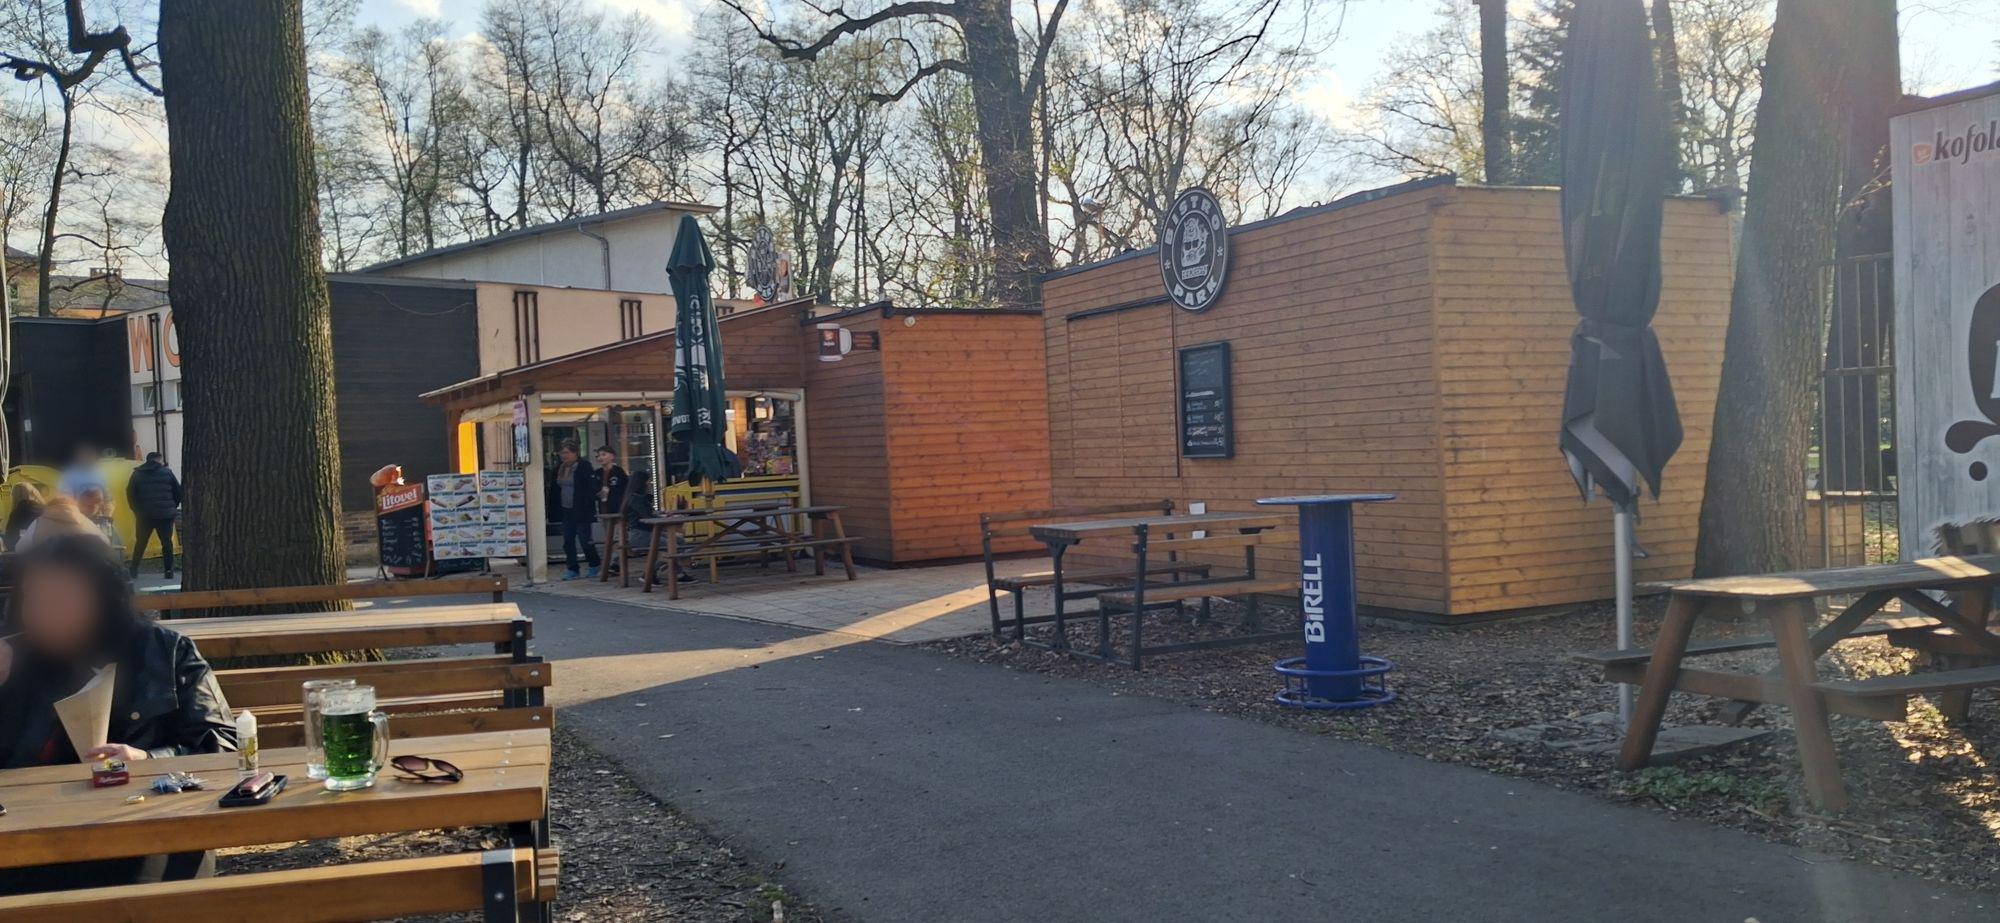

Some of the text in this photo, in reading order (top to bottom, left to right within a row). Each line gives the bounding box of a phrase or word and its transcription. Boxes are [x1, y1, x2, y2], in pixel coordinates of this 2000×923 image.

[1165, 196, 1220, 245] BISTRO
[1173, 275, 1217, 306] PARK
[382, 488, 417, 509] Litovel
